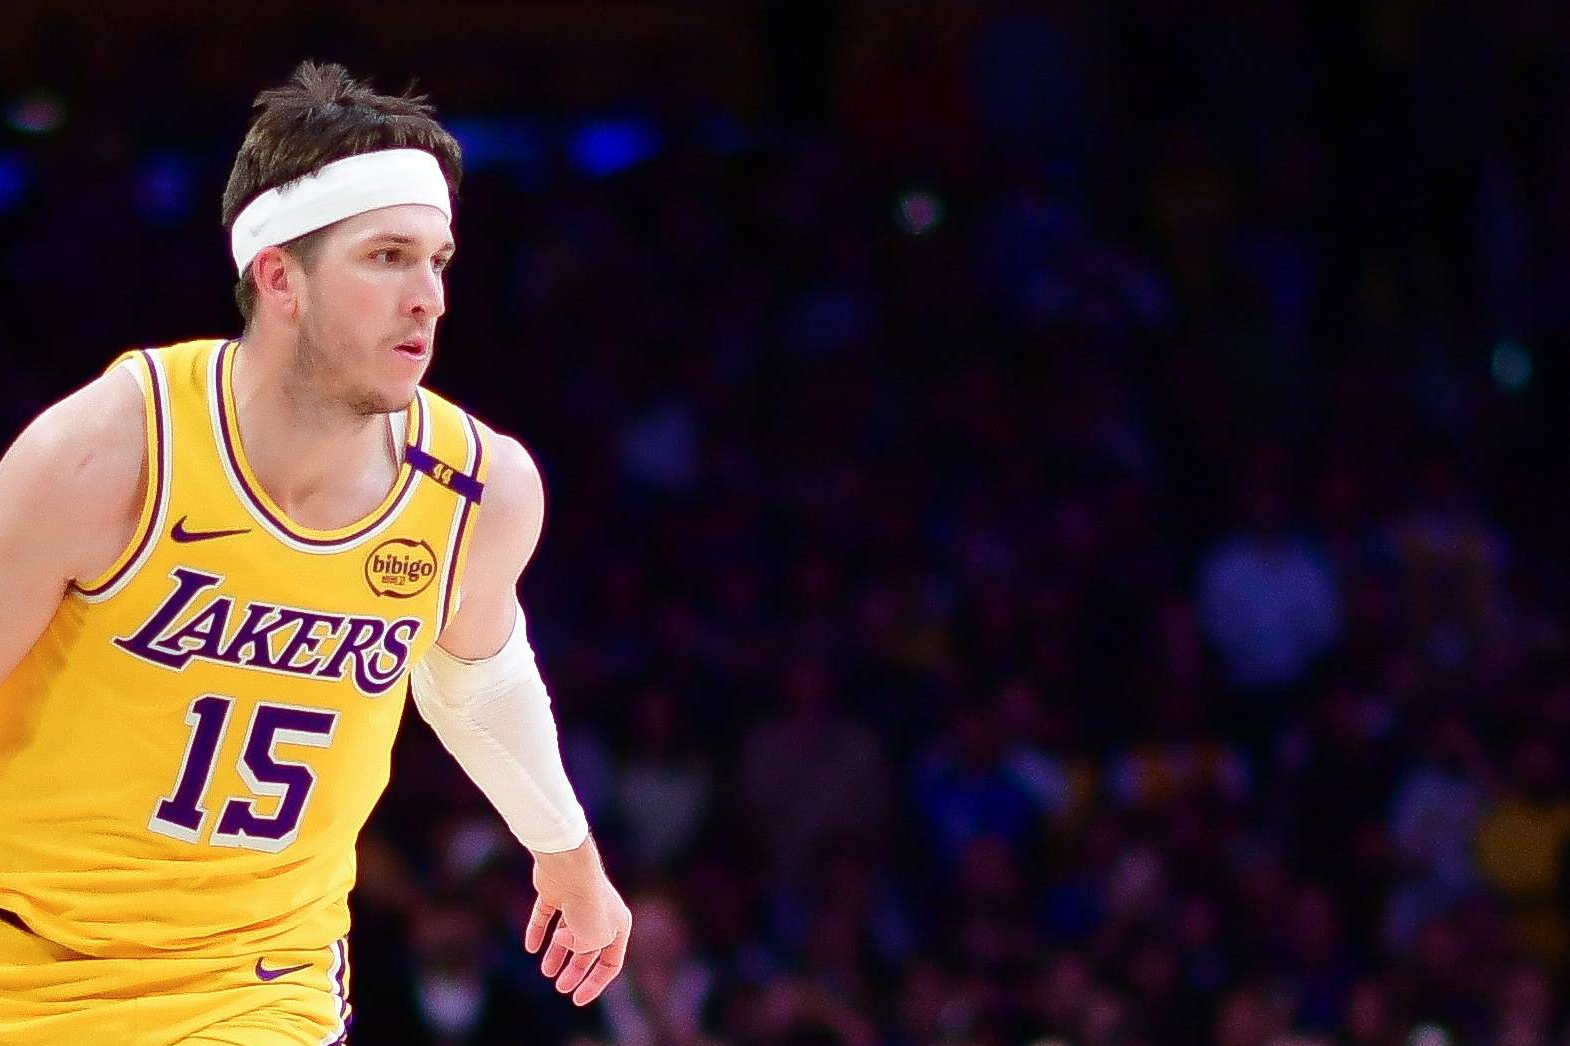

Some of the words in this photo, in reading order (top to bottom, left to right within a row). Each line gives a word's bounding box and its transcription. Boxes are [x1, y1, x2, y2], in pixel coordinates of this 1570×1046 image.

[433, 463, 454, 485] 44
[373, 554, 433, 582] bibigo
[111, 567, 423, 697] LAKERS
[147, 693, 340, 854] 15
